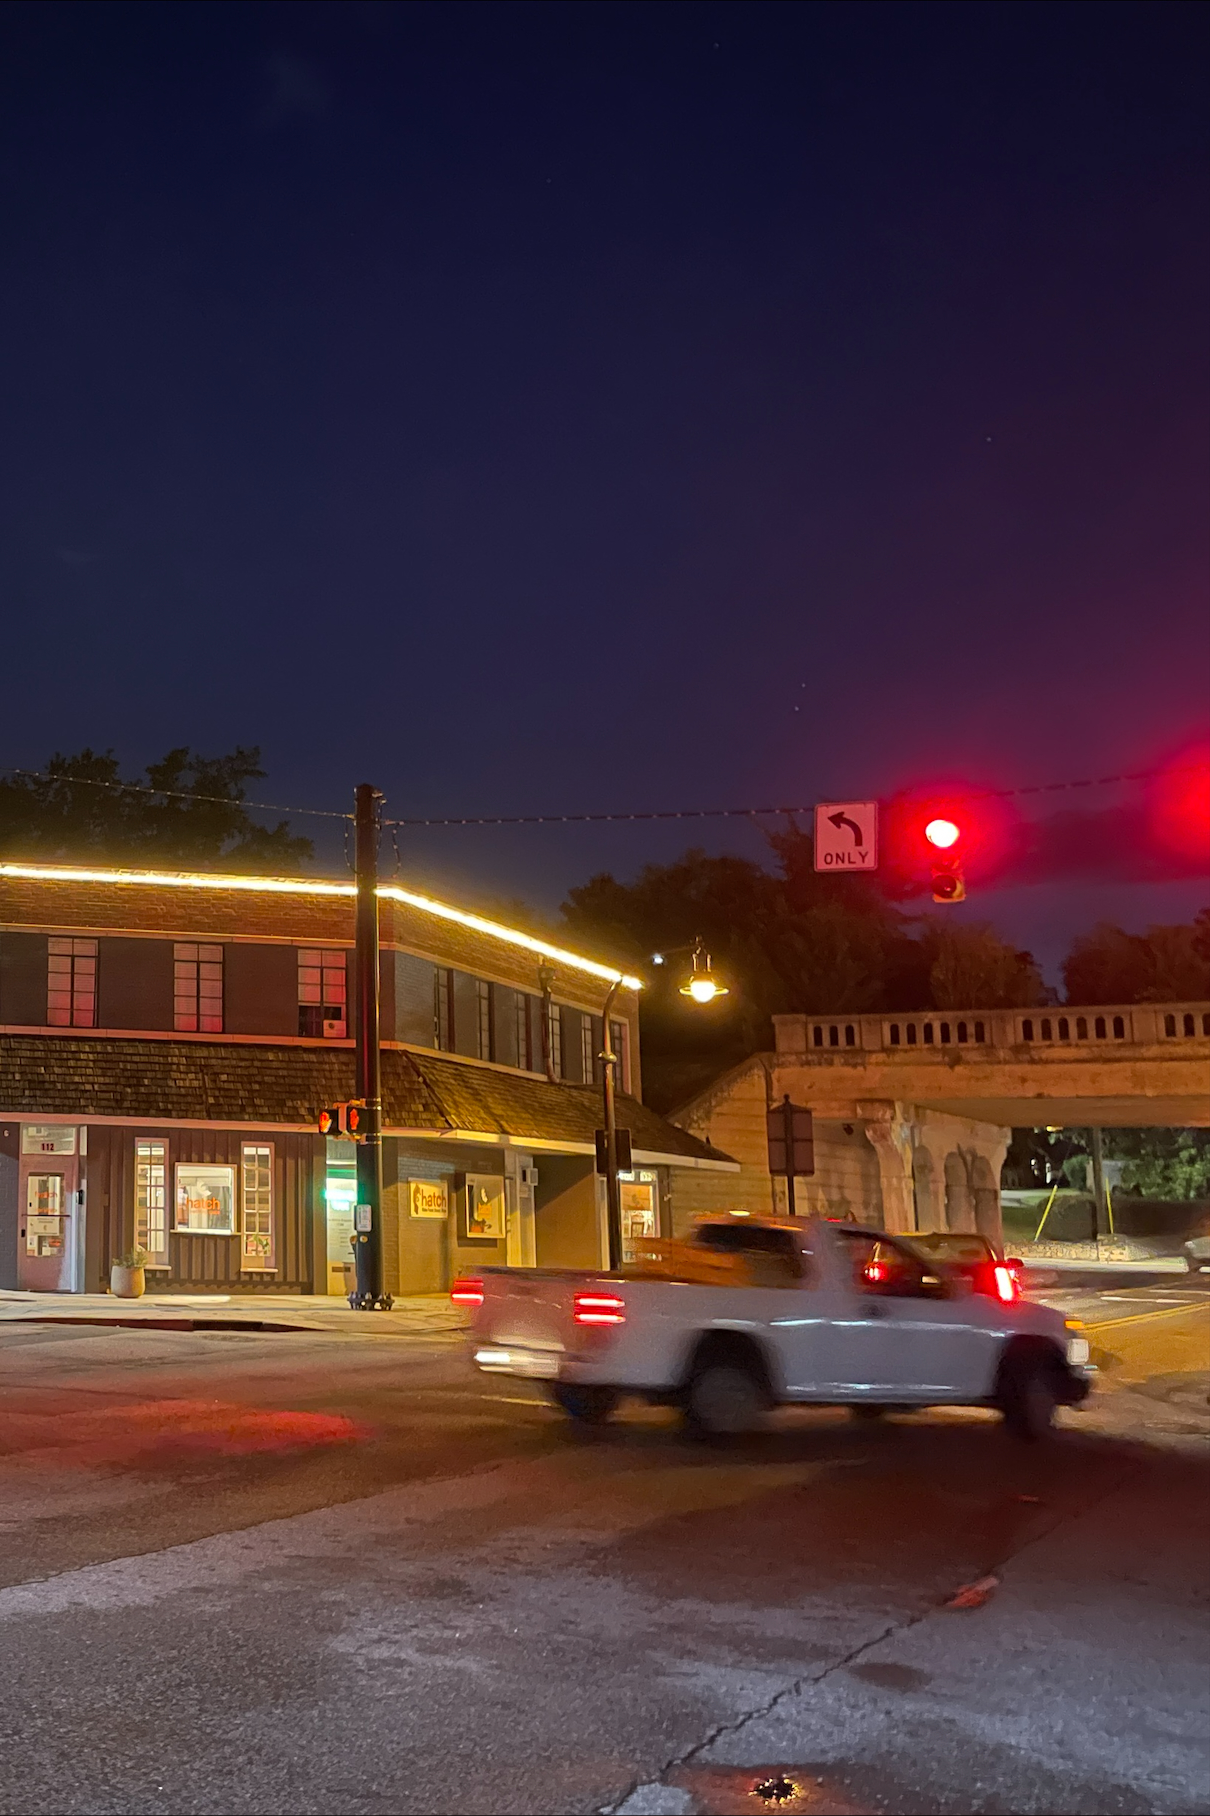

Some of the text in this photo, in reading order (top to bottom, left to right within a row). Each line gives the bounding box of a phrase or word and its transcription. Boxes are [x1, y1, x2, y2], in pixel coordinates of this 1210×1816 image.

[824, 851, 869, 866] ONLY
[41, 1143, 55, 1151] 112
[186, 1196, 221, 1210] hatch
[421, 1188, 447, 1208] hatch
